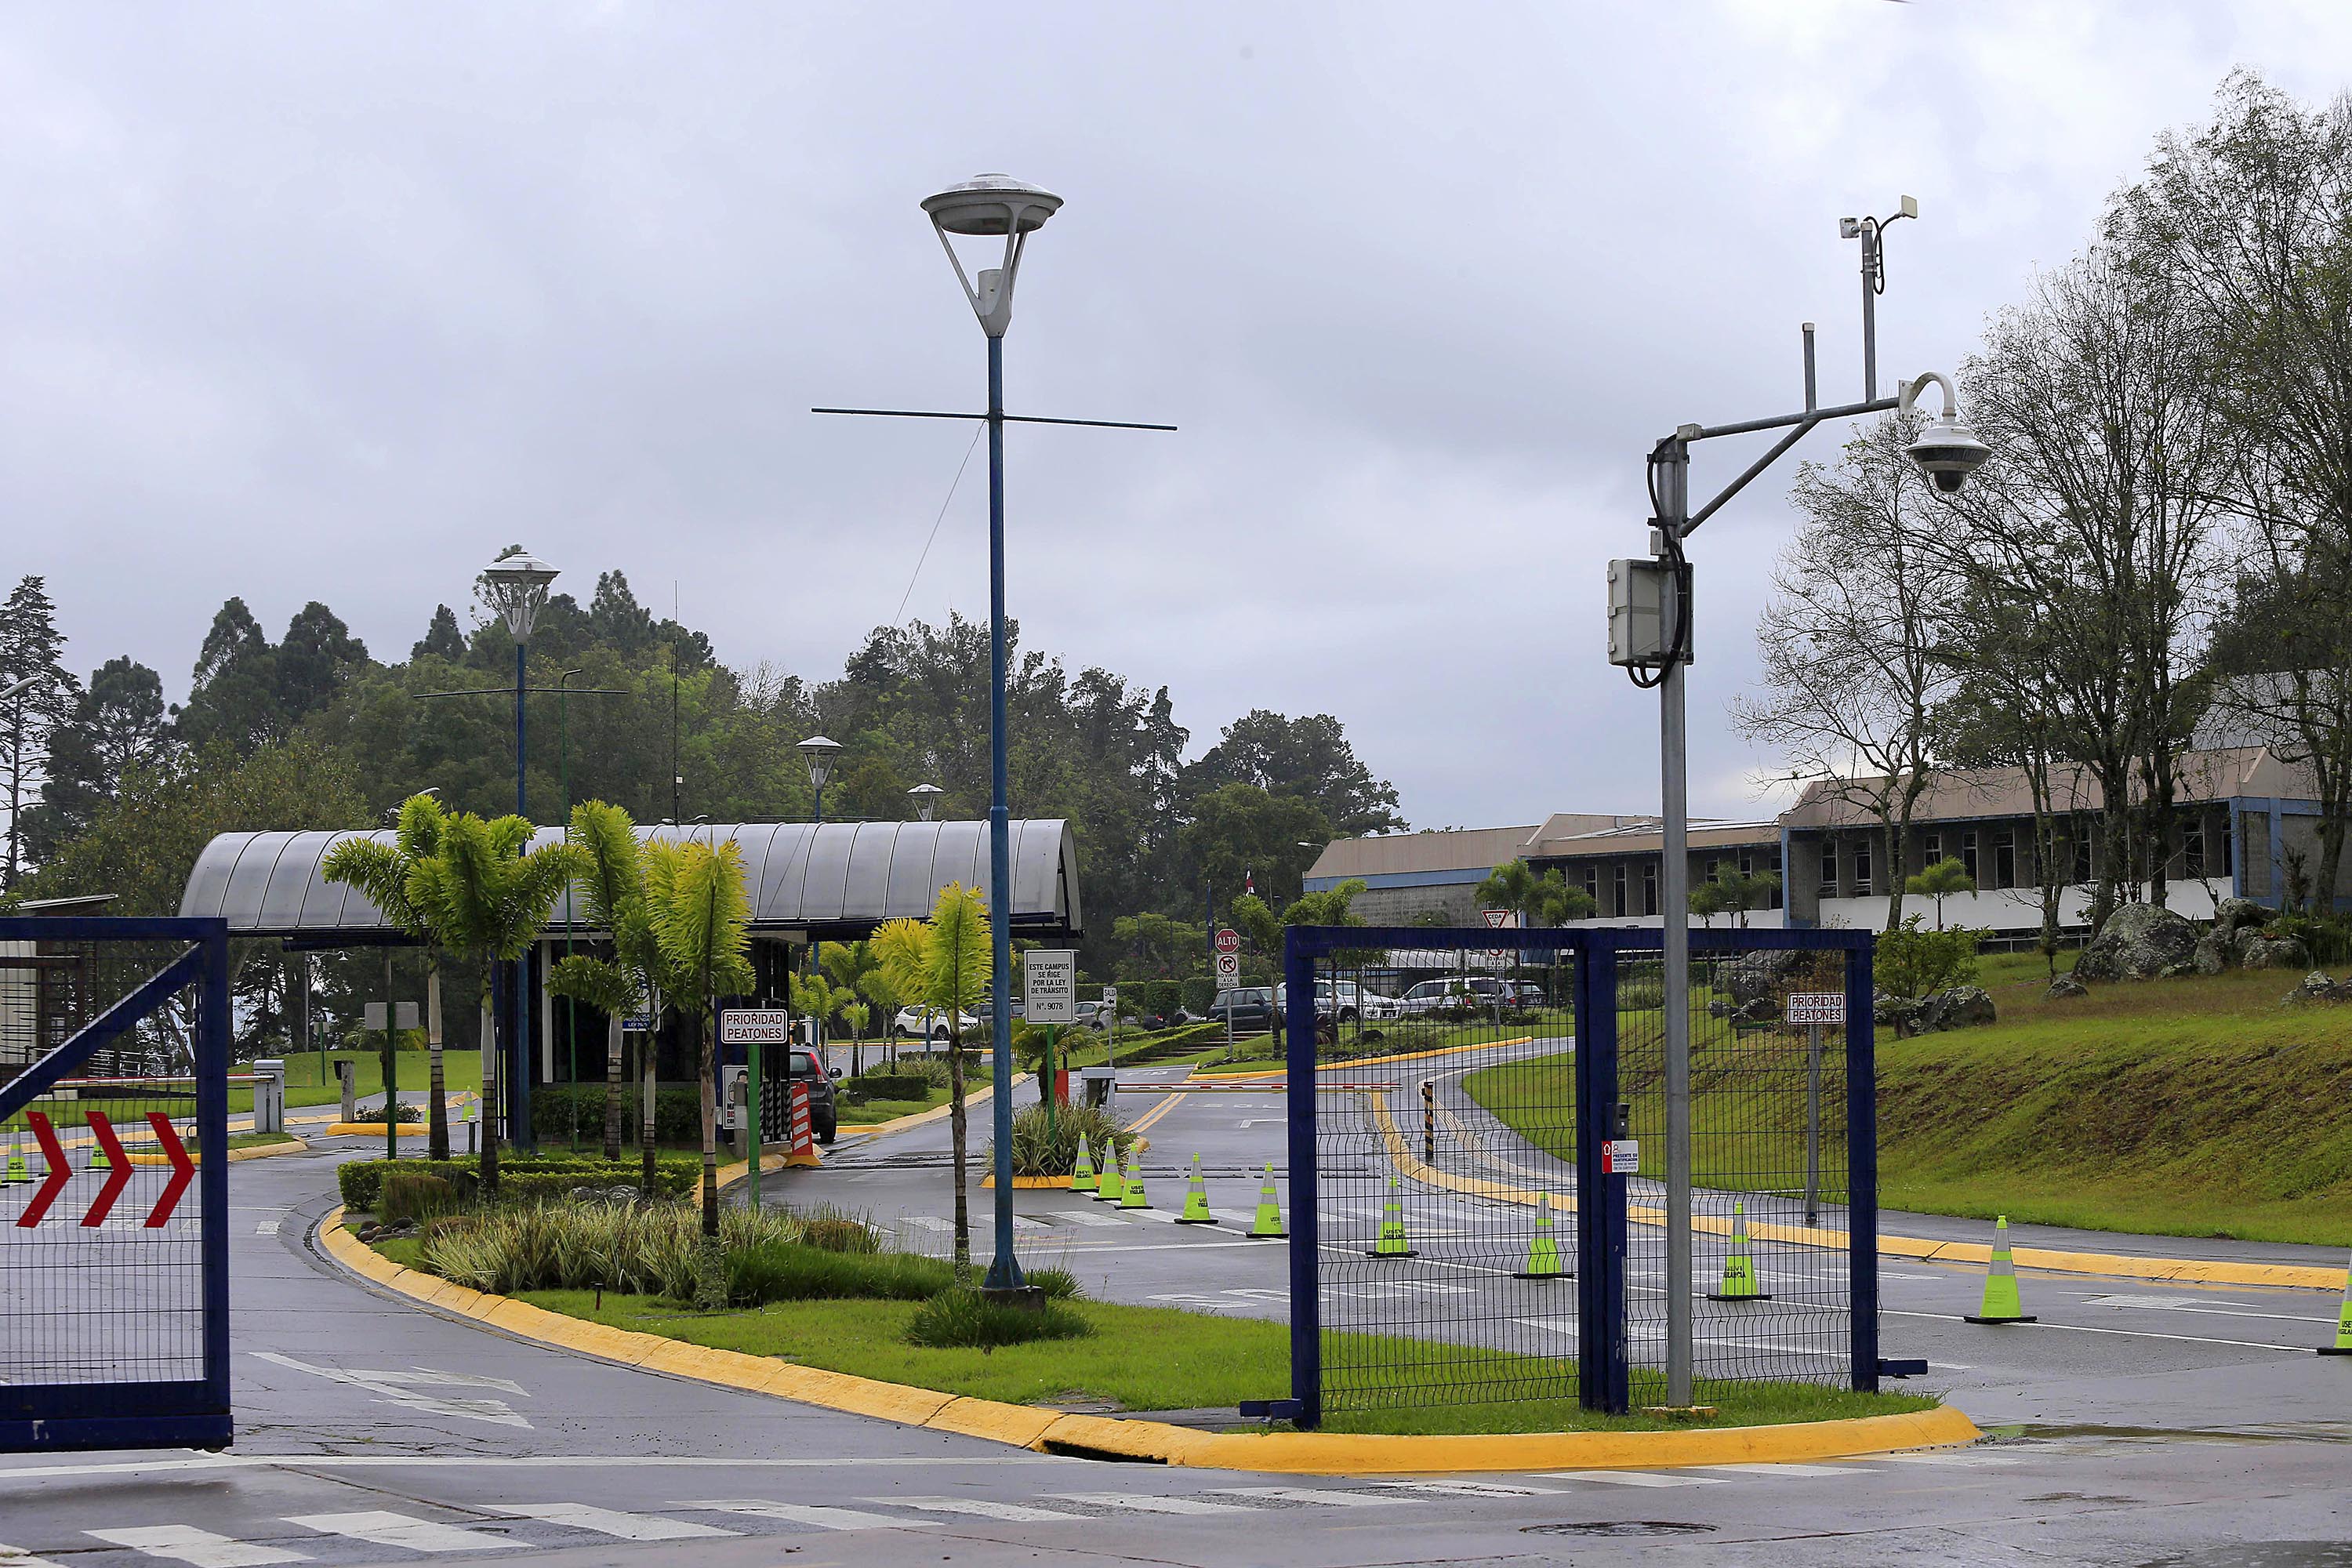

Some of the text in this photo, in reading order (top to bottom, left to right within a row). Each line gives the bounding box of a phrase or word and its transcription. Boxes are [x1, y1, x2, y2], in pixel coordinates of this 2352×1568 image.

[1218, 936, 1237, 946] ALTO
[1792, 996, 1842, 1007] PRIORIDAD
[727, 1014, 782, 1025] PRIORIDAD
[1793, 1010, 1841, 1020] PEATONES
[728, 1028, 782, 1039] PEATONES
